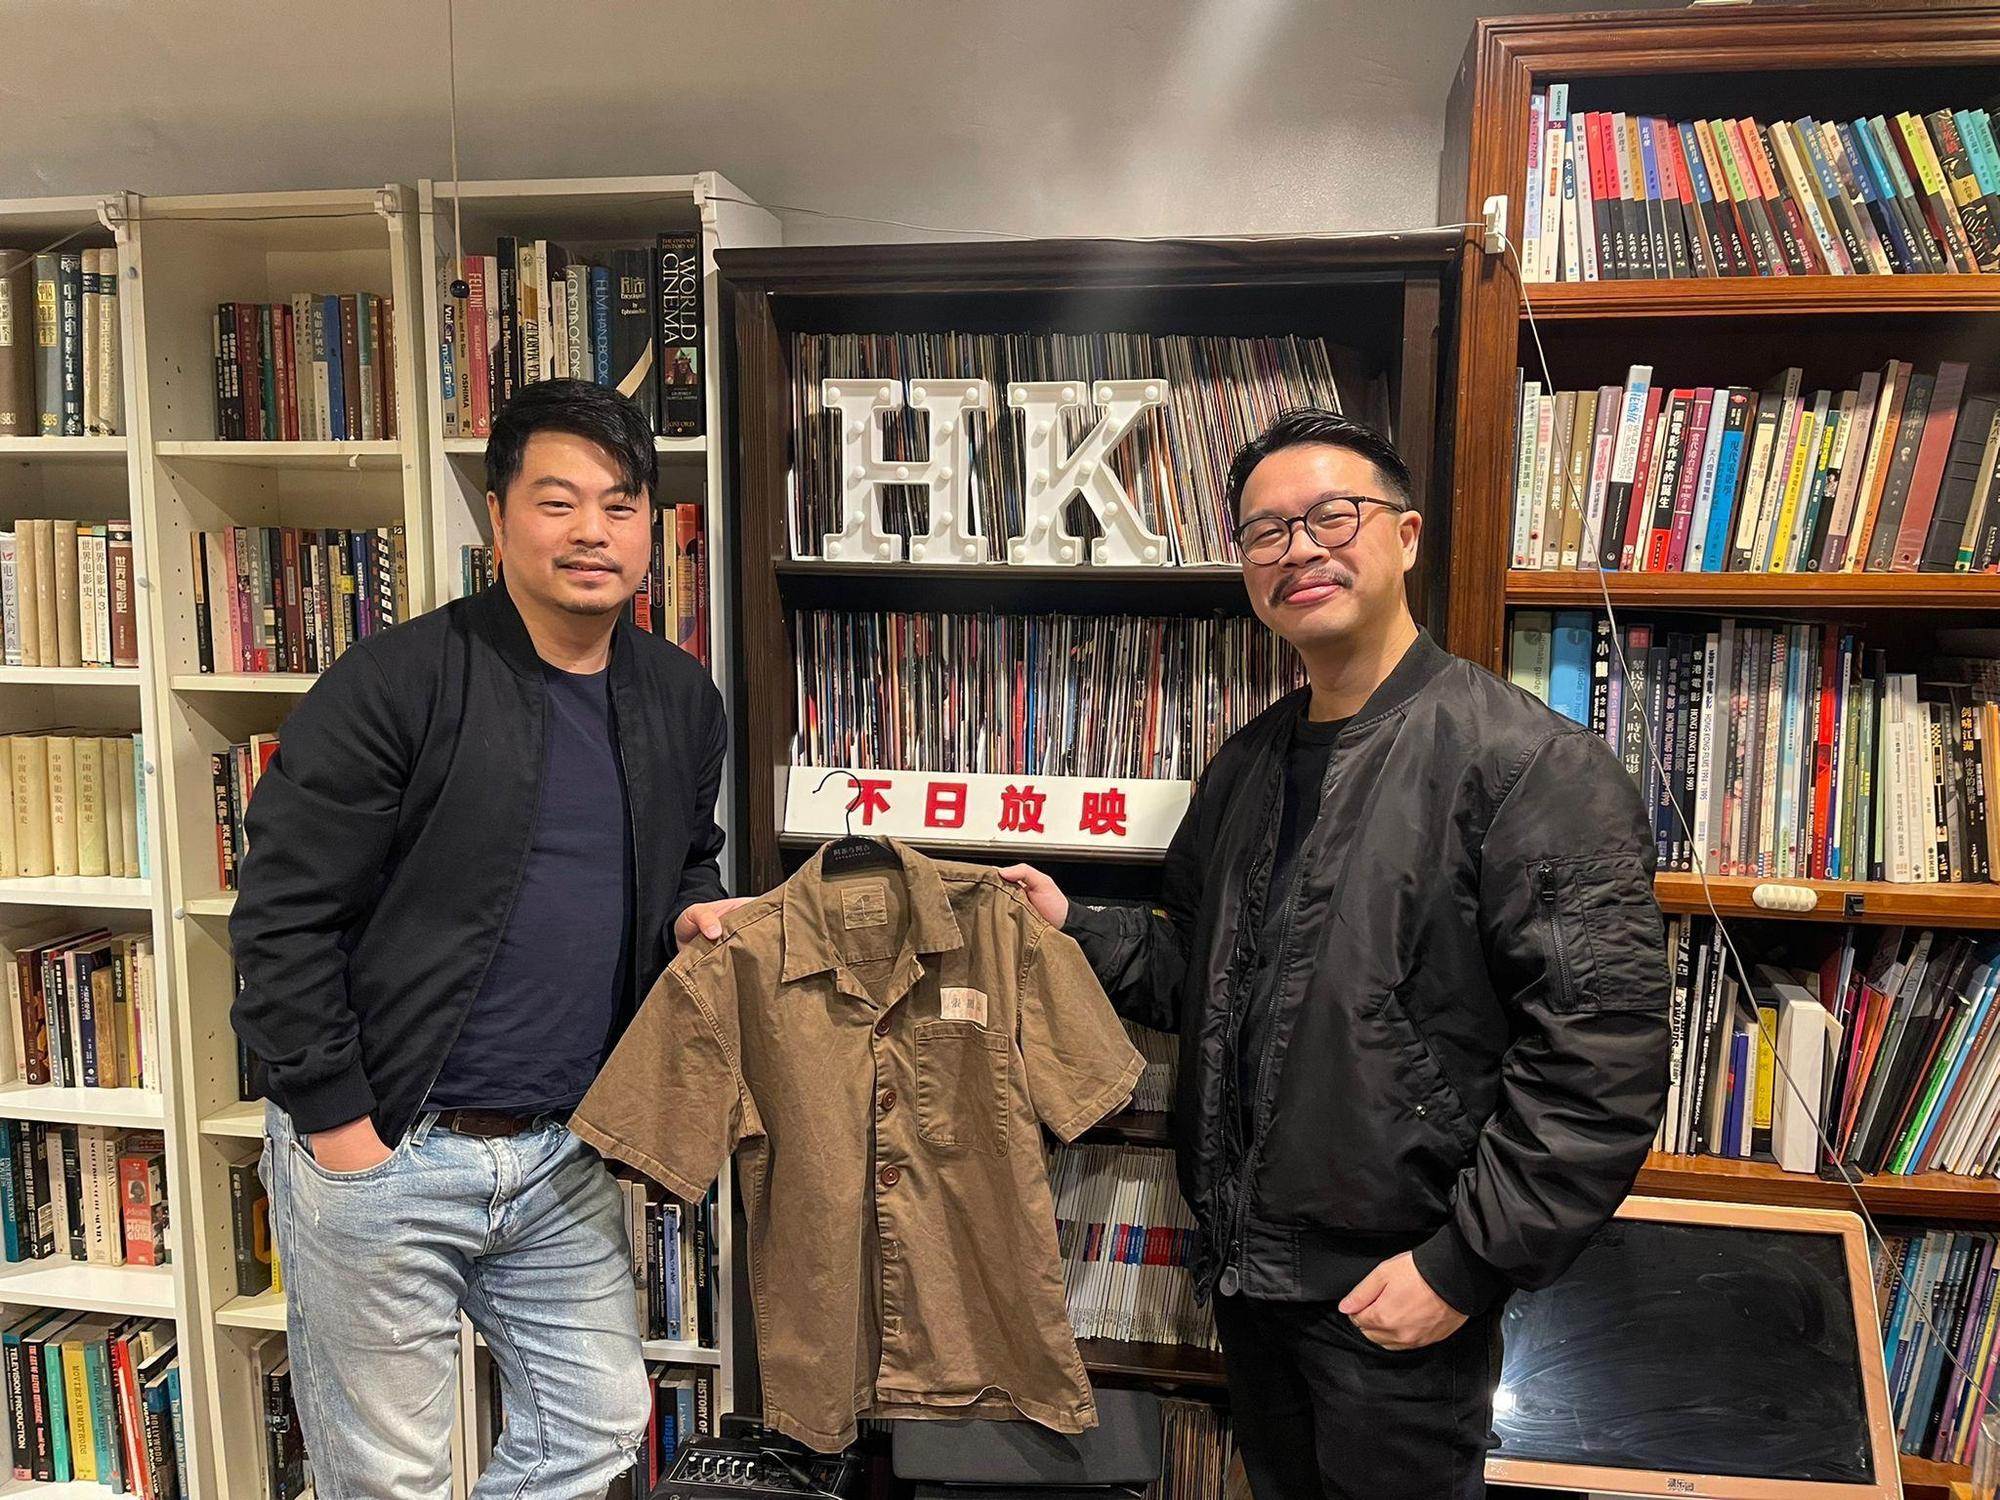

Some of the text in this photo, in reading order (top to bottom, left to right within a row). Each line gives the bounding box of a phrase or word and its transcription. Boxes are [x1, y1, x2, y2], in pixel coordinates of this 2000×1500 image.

[661, 253, 680, 345] CINEMA
[678, 255, 697, 341] WORLD
[570, 345, 581, 379] LONE
[461, 373, 470, 408] OSHIMA
[821, 378, 1168, 567] HK
[82, 541, 93, 598] 世界电影史
[98, 601, 105, 610] 3
[303, 586, 316, 640] 電影世界
[1533, 666, 1543, 690] guide
[1664, 713, 1674, 732] HONG
[1690, 708, 1699, 729] HONG
[1704, 713, 1712, 732] HONG
[1663, 734, 1673, 753] KONG
[1689, 731, 1698, 751] KONG
[1702, 733, 1710, 751] KONG
[1663, 754, 1672, 771] FILMS
[1687, 753, 1697, 774] FILMS
[1701, 752, 1709, 768] FILMS
[845, 778, 1128, 837] 不日放映
[4, 1157, 15, 1222] UNDERSTANDING
[696, 1230, 705, 1245] Five
[10, 1347, 26, 1449] TELEVISION PRODUCTION
[72, 1365, 82, 1398] MOVIES
[172, 1399, 180, 1412] The
[697, 1379, 707, 1433] HISTORY OF
[76, 1417, 87, 1454] METHODS
[151, 1415, 163, 1462] HOLLYWOOD
[173, 1413, 182, 1432] Films
[663, 1415, 676, 1463] magnu
